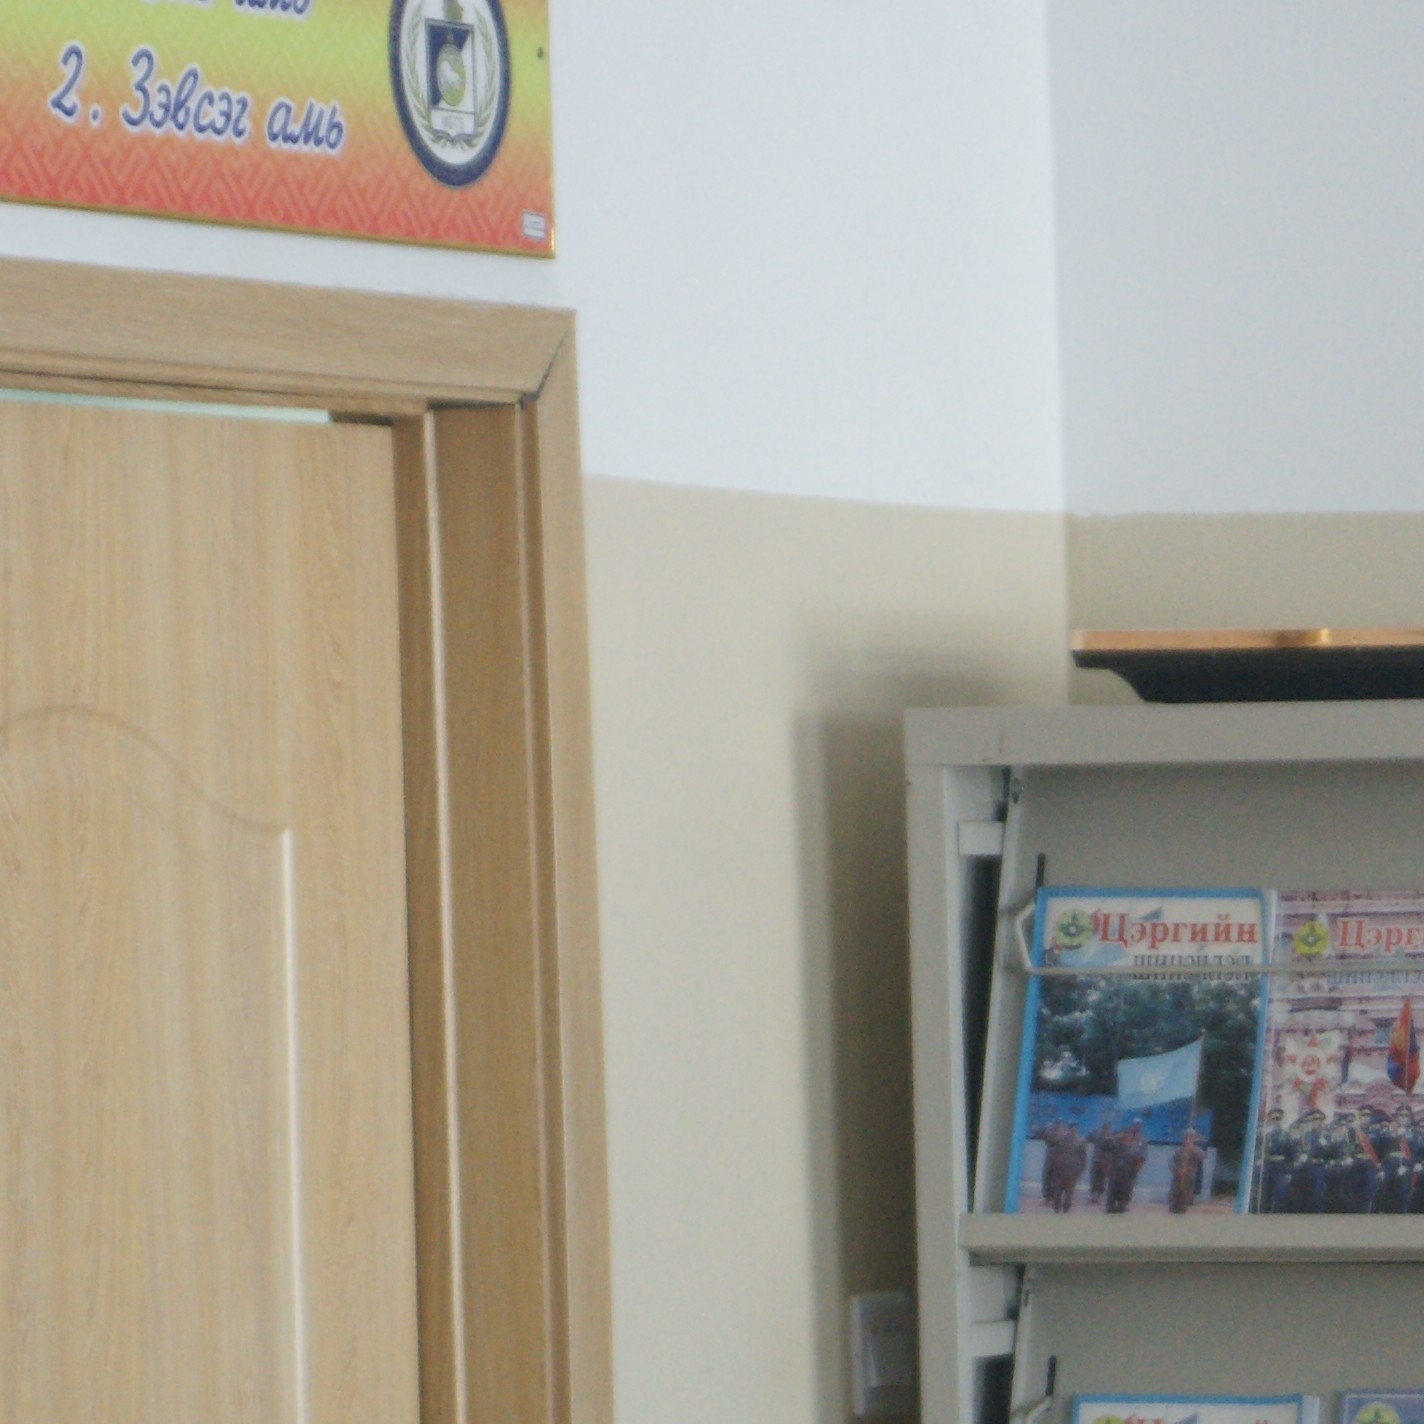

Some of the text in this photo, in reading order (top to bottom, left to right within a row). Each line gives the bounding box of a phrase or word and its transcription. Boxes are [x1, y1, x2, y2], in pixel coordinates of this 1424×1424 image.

[51, 45, 346, 150] 2. Зэвсэг амь
[1099, 912, 1258, 949] Цэргийн
